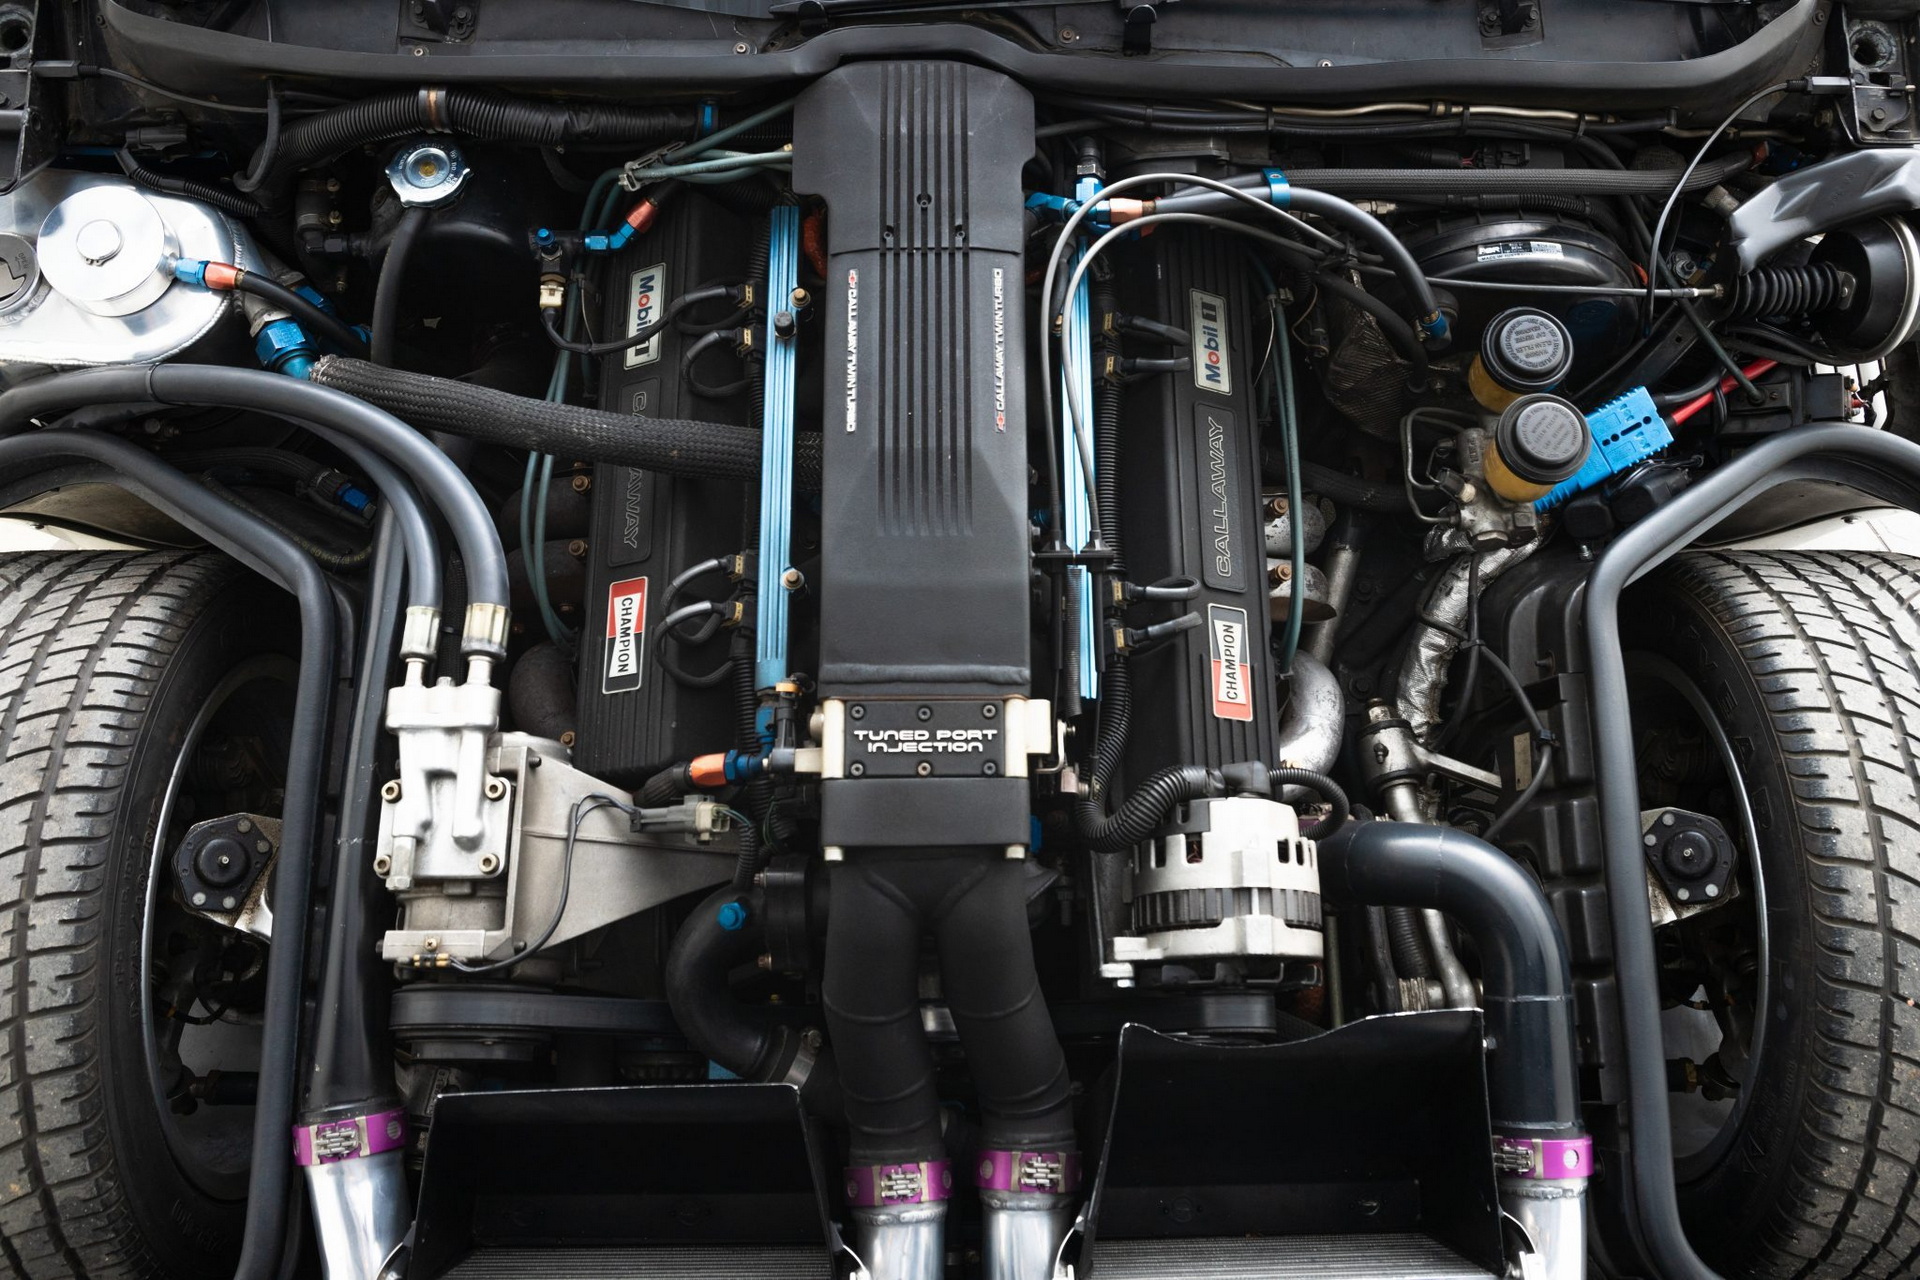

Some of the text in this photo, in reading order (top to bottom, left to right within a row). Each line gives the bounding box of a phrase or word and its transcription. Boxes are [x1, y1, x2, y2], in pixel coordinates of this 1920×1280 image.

[994, 345, 1005, 411] CALLAWAY
[1202, 325, 1222, 384] Mobil
[624, 391, 647, 548] CAWAY
[1208, 416, 1232, 577] CALLAWAY
[617, 597, 633, 673] CHAMPION
[1222, 624, 1238, 700] CHAMPION
[853, 729, 998, 741] TUNED PORT
[867, 742, 984, 753] INJECTION
